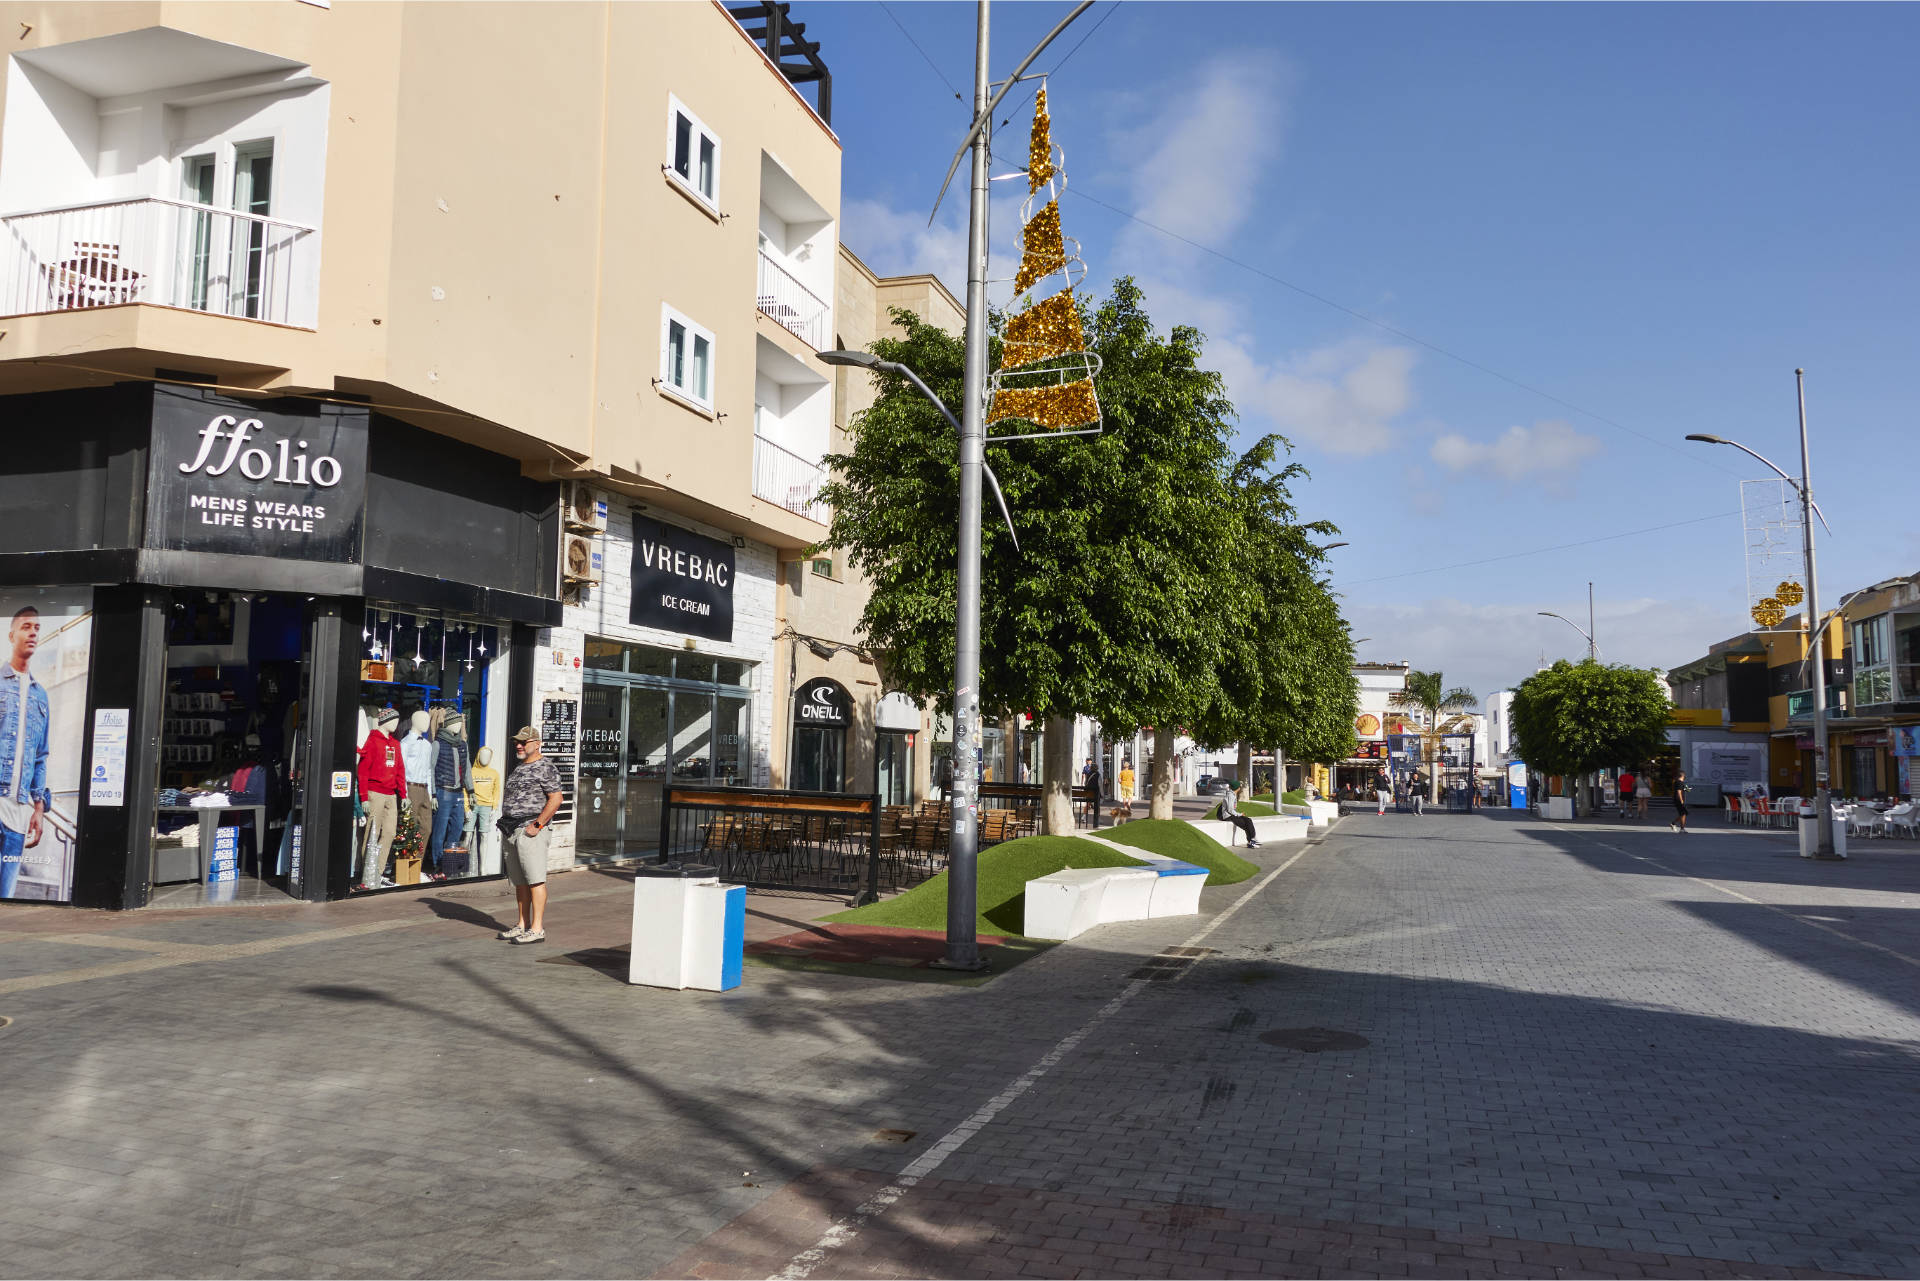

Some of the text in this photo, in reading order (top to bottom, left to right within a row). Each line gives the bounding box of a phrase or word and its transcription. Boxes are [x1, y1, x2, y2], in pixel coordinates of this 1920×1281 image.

[179, 415, 342, 487] ffolio
[190, 495, 326, 519] MENS WEARS
[201, 512, 314, 533] LIFE STYLE
[642, 539, 728, 588] VREBAC
[662, 594, 710, 616] ICE CREAM
[801, 704, 842, 720] O'NEILL
[580, 729, 622, 742] VREBAC
[91, 790, 112, 798] COVID
